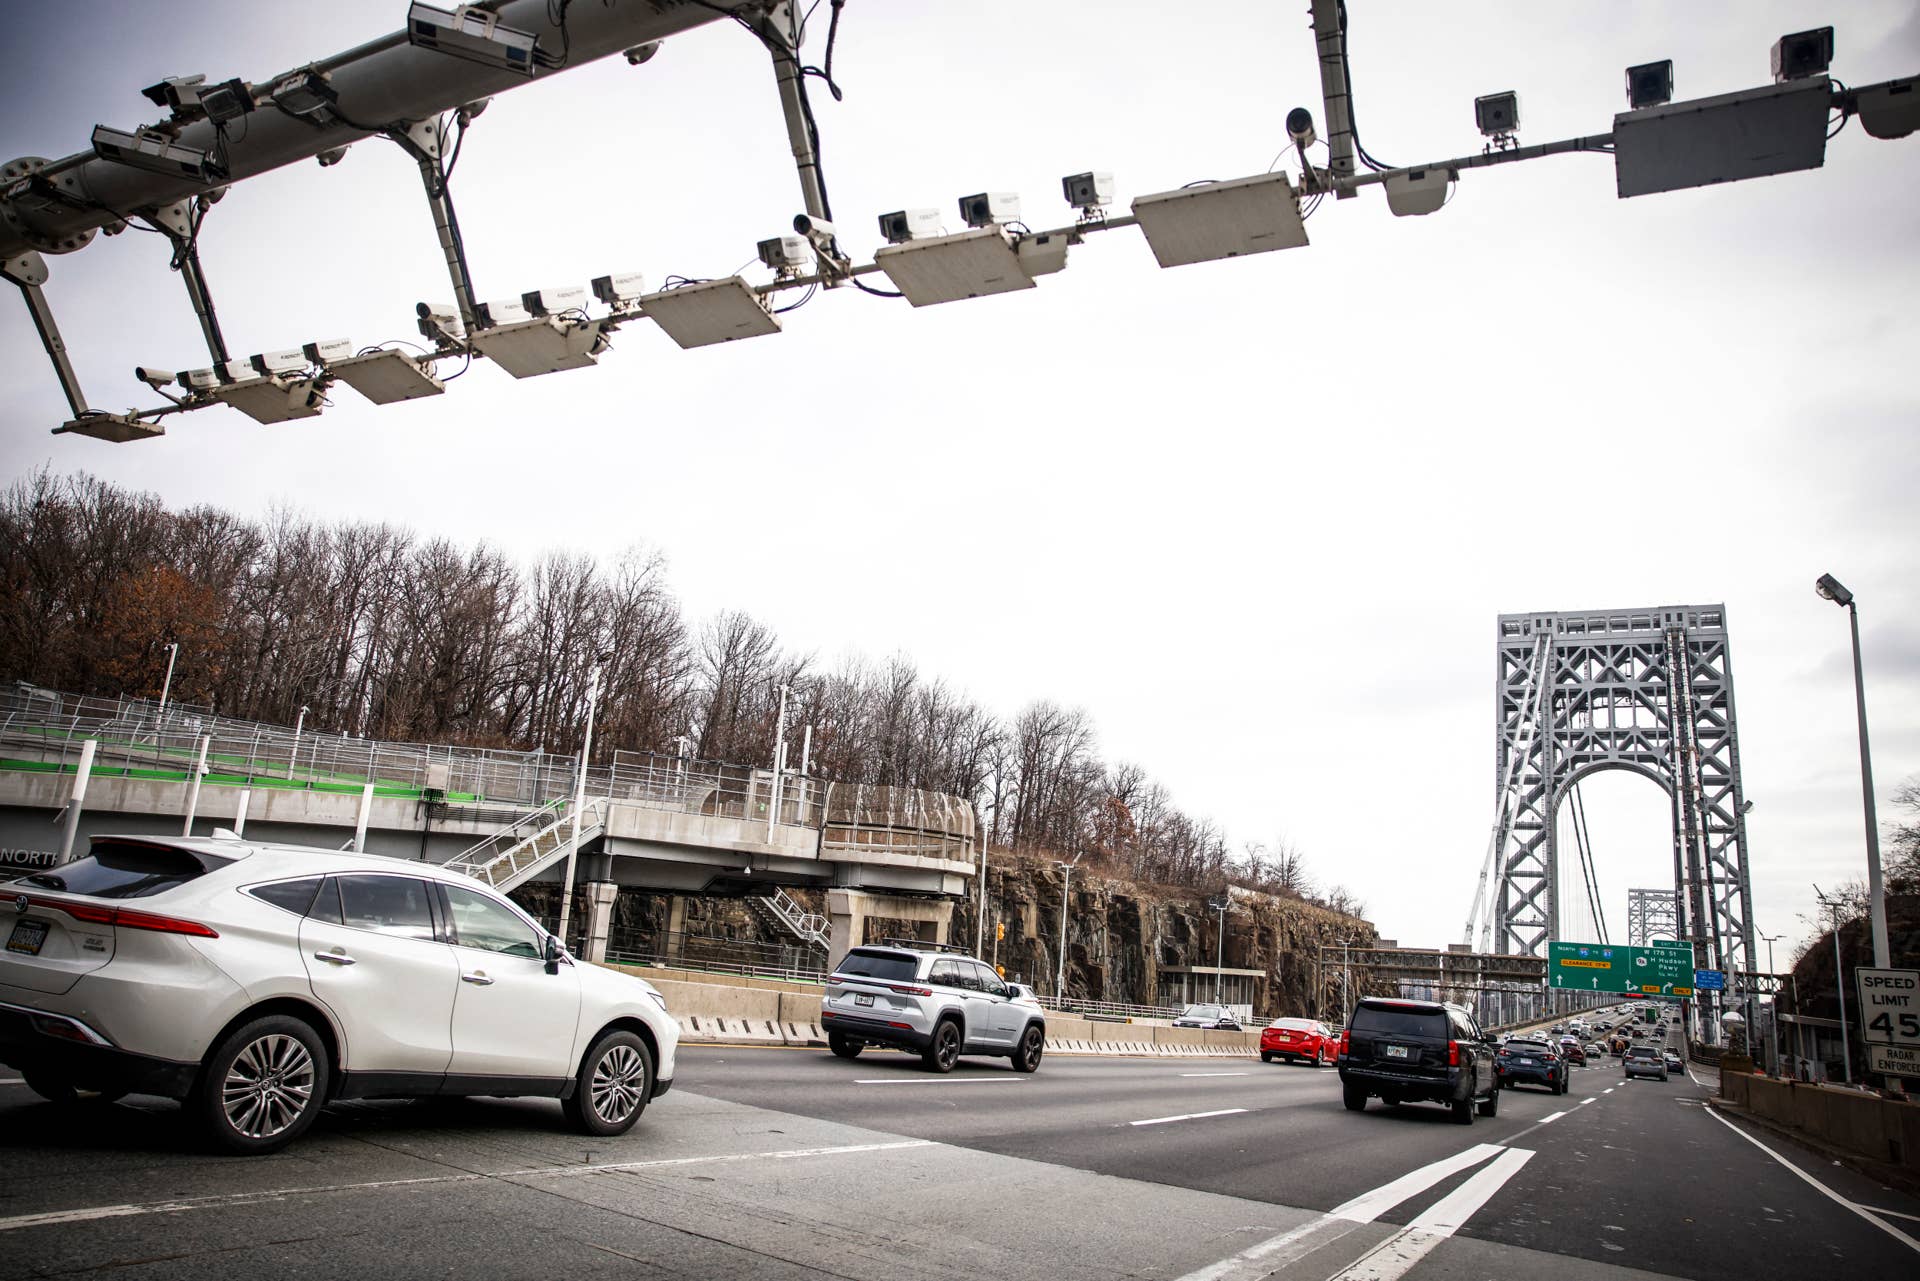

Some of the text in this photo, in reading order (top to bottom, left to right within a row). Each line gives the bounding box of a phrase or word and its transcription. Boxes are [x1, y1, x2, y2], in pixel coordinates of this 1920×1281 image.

[1659, 964, 1678, 972] Pkwy
[1864, 976, 1915, 989] SPEED
[1872, 994, 1910, 1007] LIMIT
[1869, 1011, 1920, 1038] 45
[1887, 1048, 1915, 1061] RADAR
